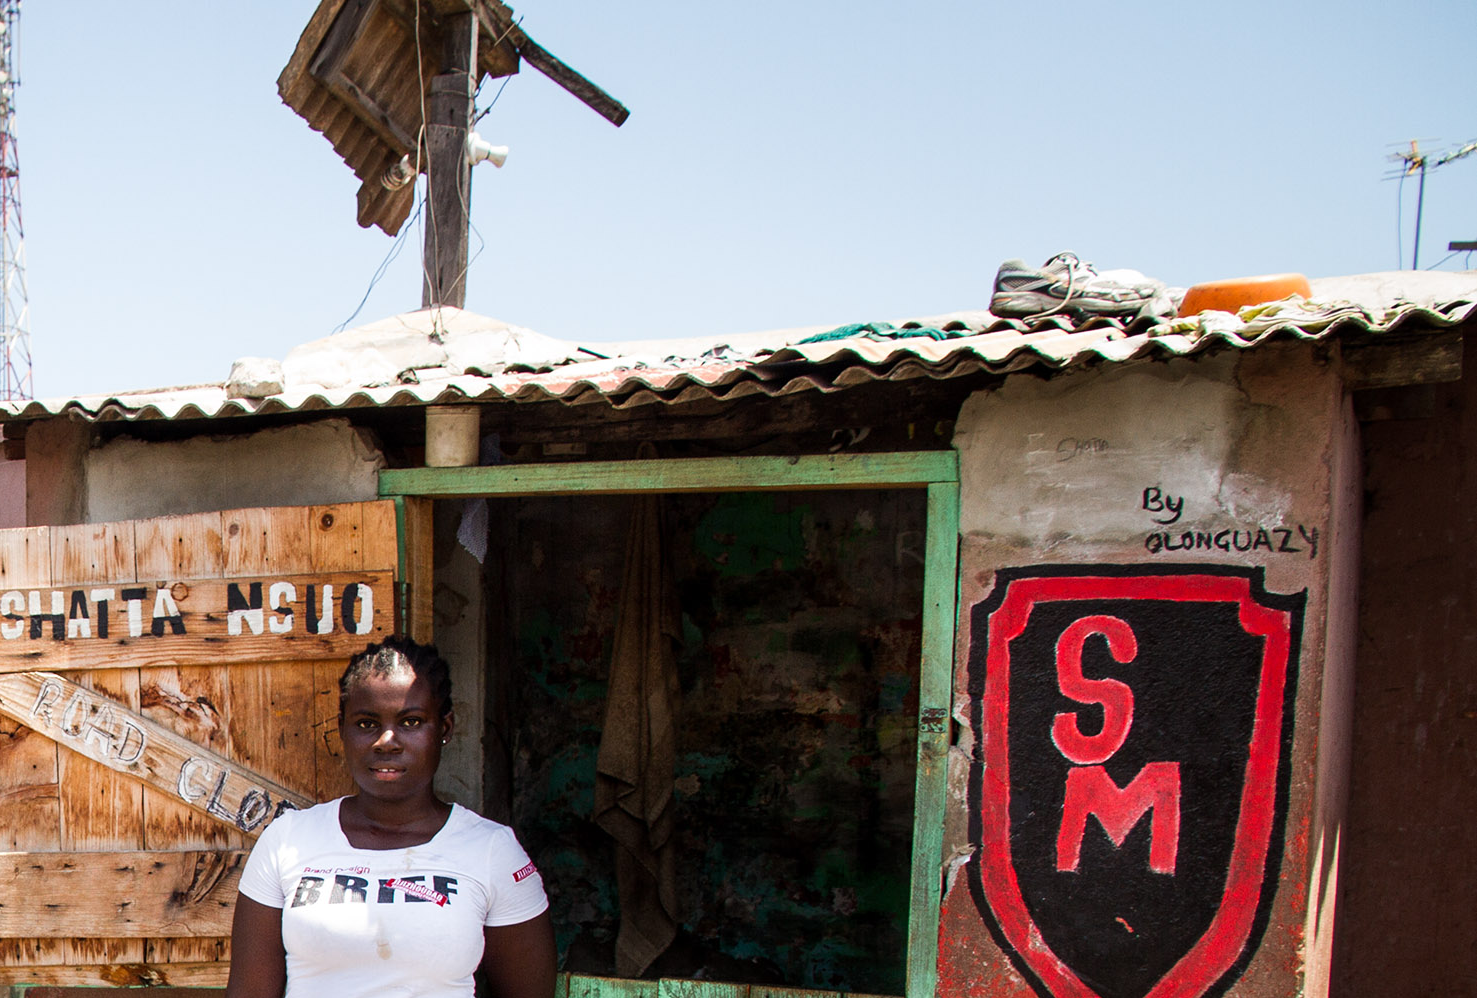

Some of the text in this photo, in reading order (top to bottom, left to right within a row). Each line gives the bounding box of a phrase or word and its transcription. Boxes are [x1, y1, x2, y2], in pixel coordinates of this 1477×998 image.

[1142, 487, 1184, 524] By
[0, 581, 373, 640] SHATTA NSUO
[32, 678, 147, 764] ROAD
[1056, 762, 1181, 873] M
[290, 874, 458, 908] BRIEF
